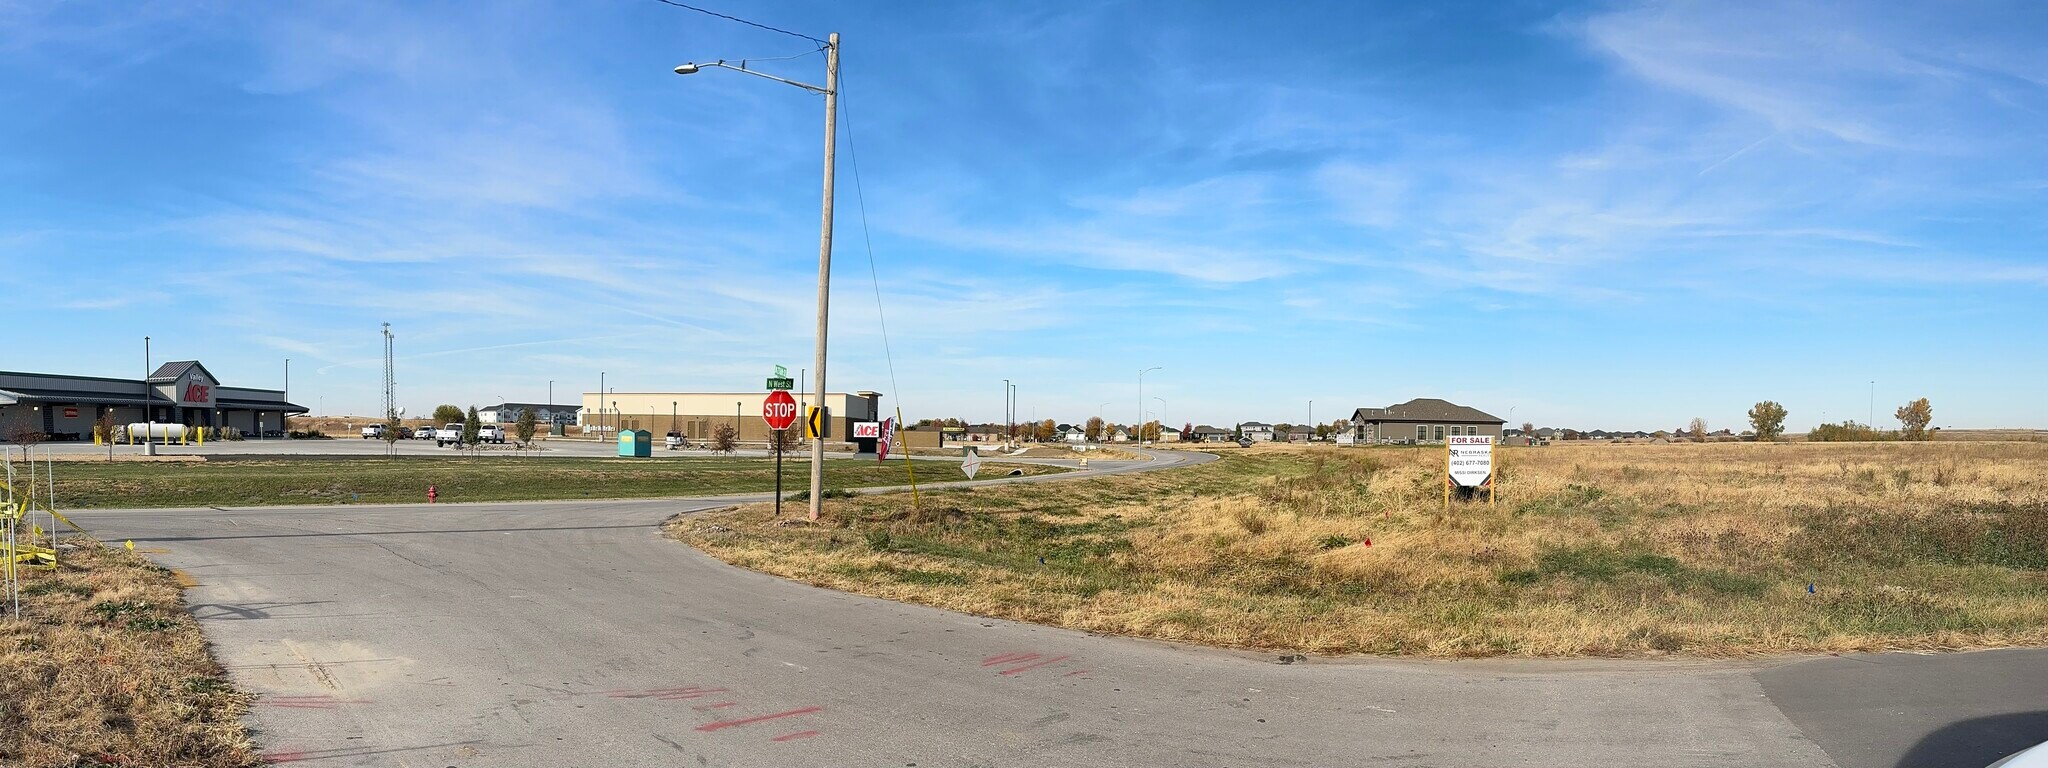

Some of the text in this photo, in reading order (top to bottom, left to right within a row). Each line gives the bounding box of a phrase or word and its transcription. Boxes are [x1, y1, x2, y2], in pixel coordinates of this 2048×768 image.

[189, 373, 204, 382] Valley
[773, 380, 785, 388] West
[184, 381, 209, 402] ACE
[765, 403, 795, 417] STOP
[855, 424, 878, 436] ACE
